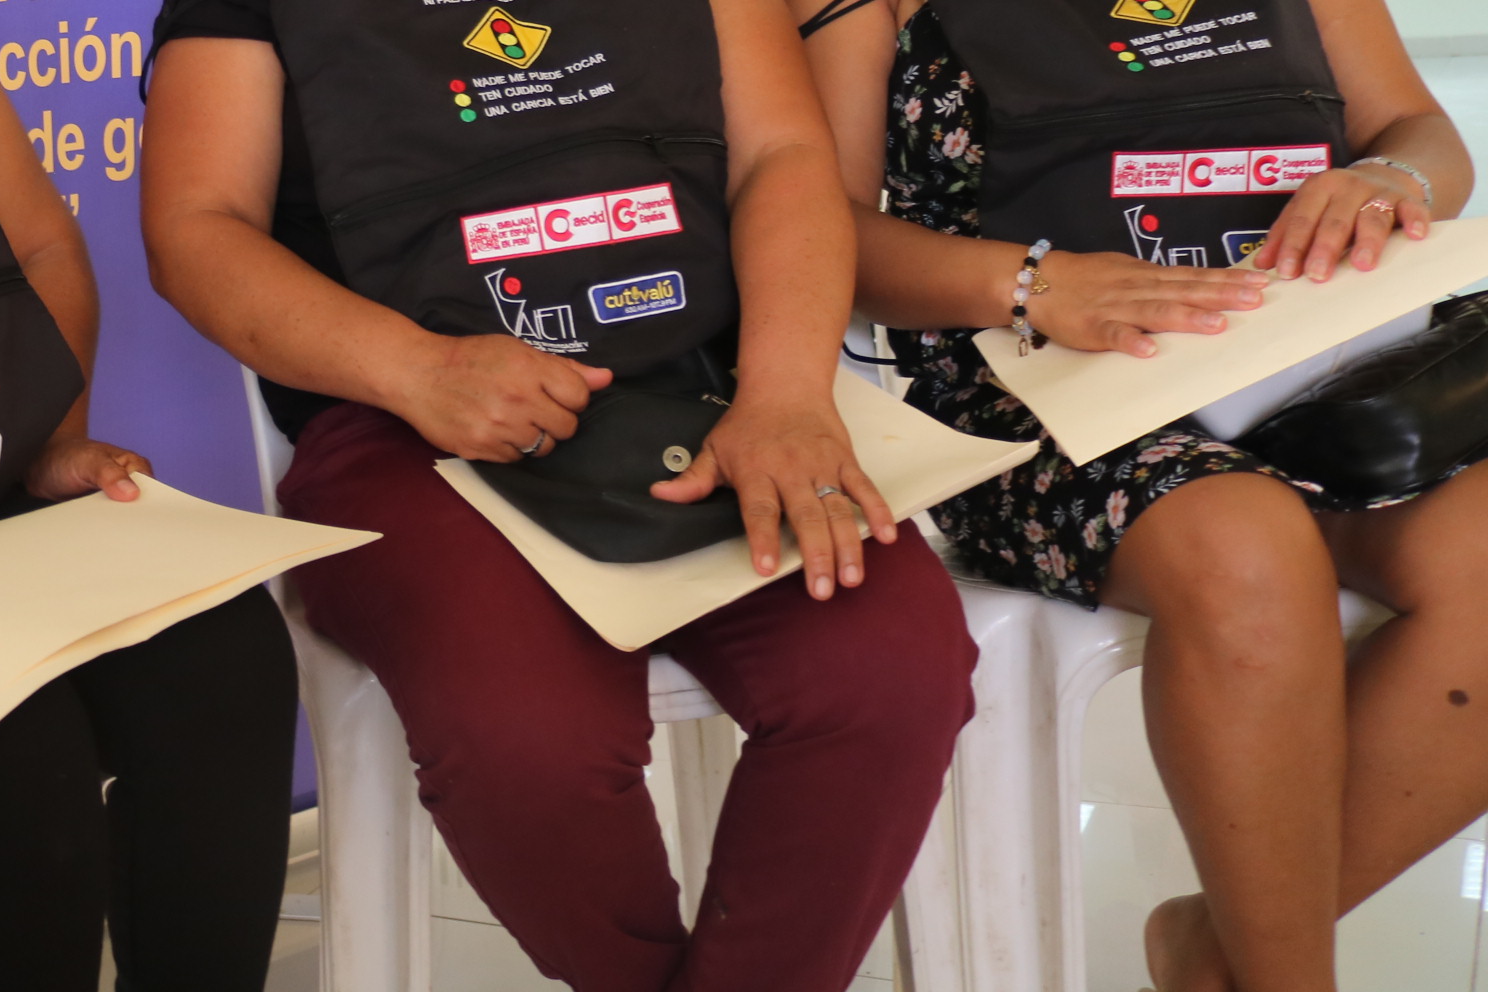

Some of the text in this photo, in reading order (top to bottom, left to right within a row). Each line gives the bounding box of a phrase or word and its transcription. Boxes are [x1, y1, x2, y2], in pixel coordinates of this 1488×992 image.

[473, 53, 606, 88] NADIE ME PUEDE TOCAR
[479, 84, 552, 102] TEN CUIDADO
[484, 82, 614, 117] UNA CARICIA ESTÁ BIEN
[1215, 164, 1245, 176] aecid
[573, 211, 605, 227] aecid
